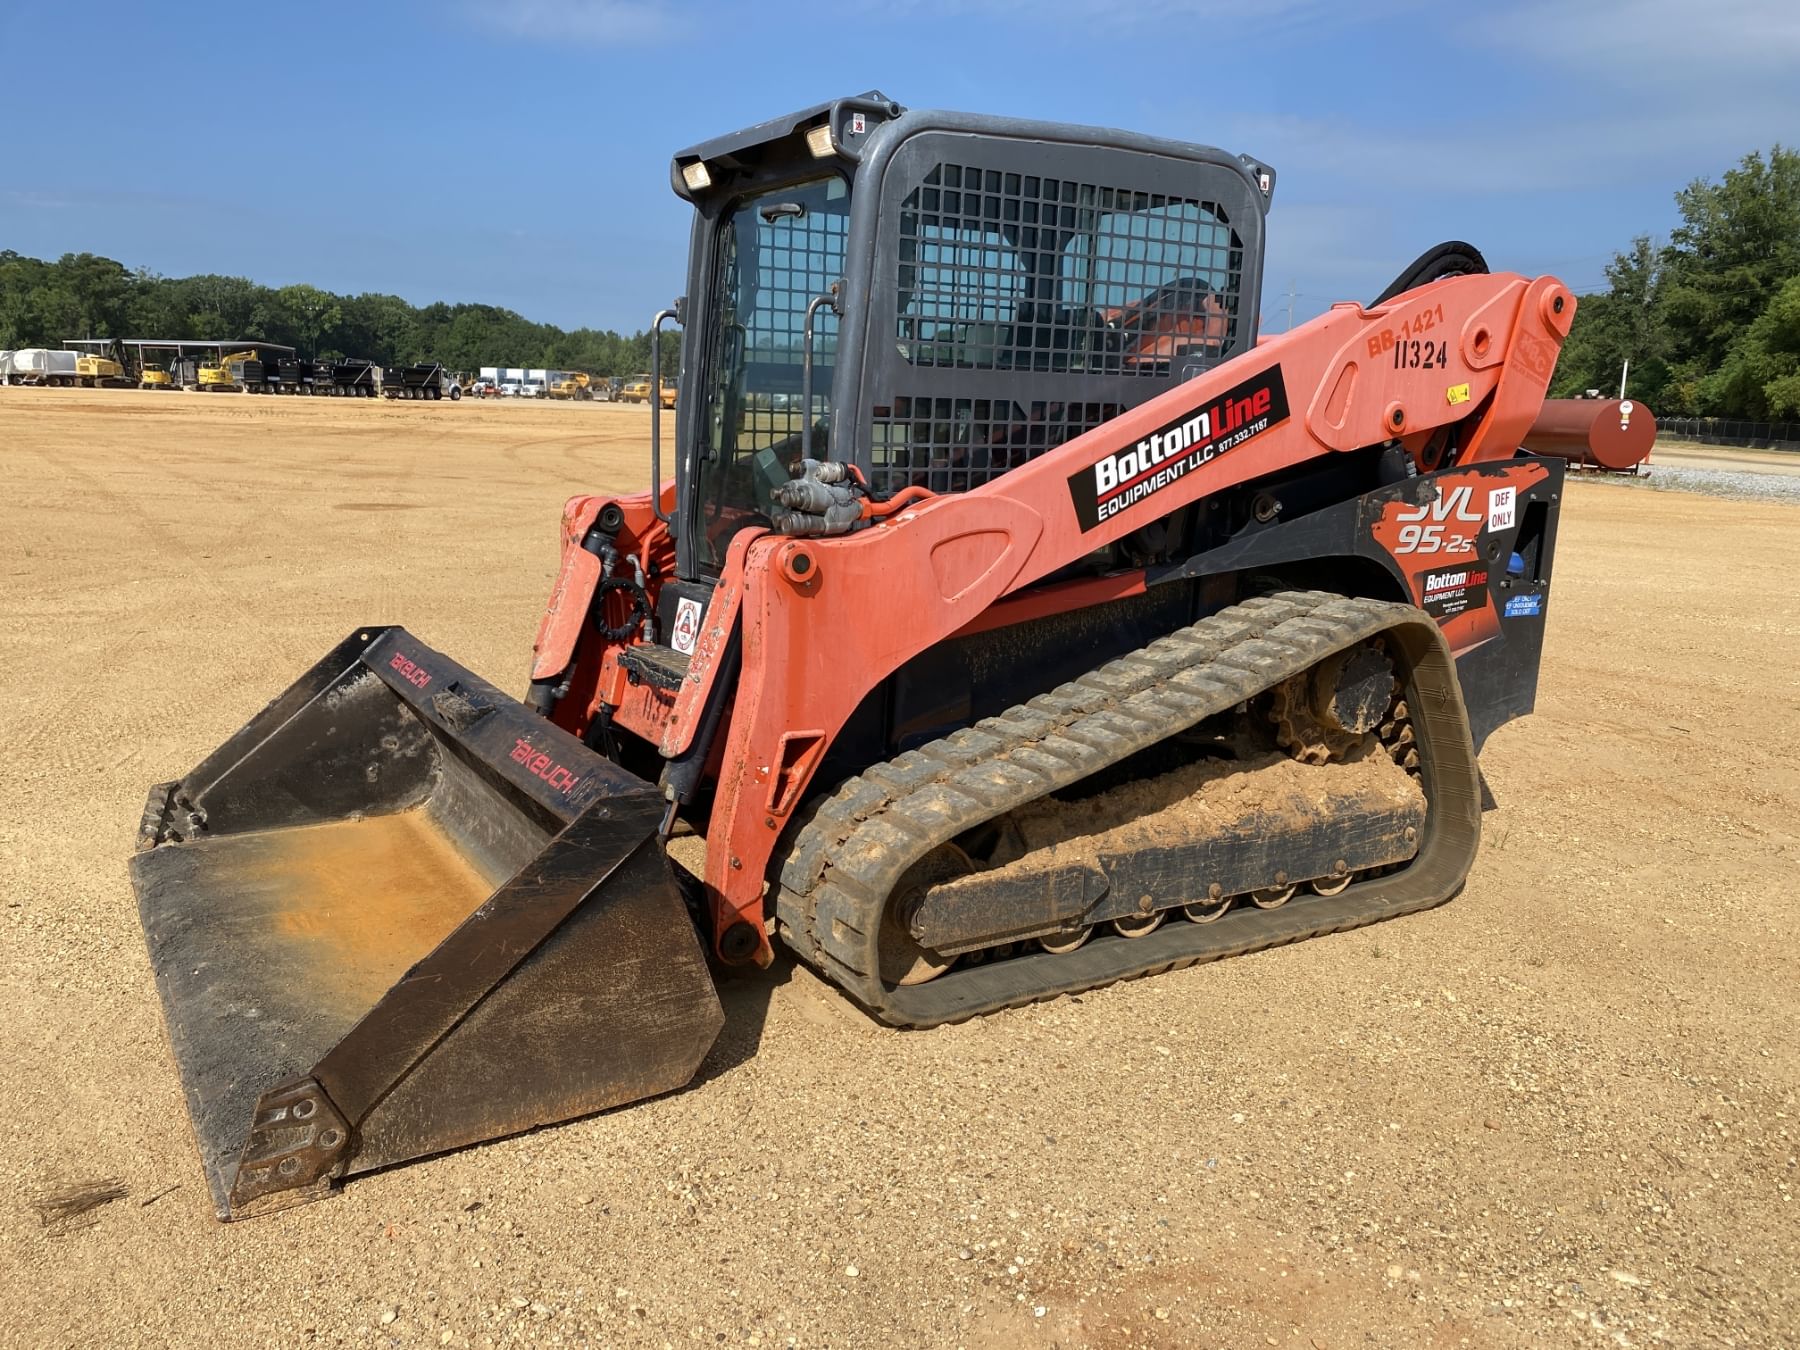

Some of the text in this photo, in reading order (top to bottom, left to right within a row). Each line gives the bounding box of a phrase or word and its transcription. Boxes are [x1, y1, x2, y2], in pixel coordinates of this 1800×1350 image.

[1394, 340, 1447, 369] 11324
[1095, 387, 1272, 496] BottomLine
[1098, 418, 1268, 521] EQUIPMENT LLC 877.332.7187
[1495, 491, 1511, 507] DEF
[1492, 511, 1512, 528] ONLY
[1426, 571, 1488, 591] BottomLine
[1424, 590, 1455, 604] EQUIPMENT
